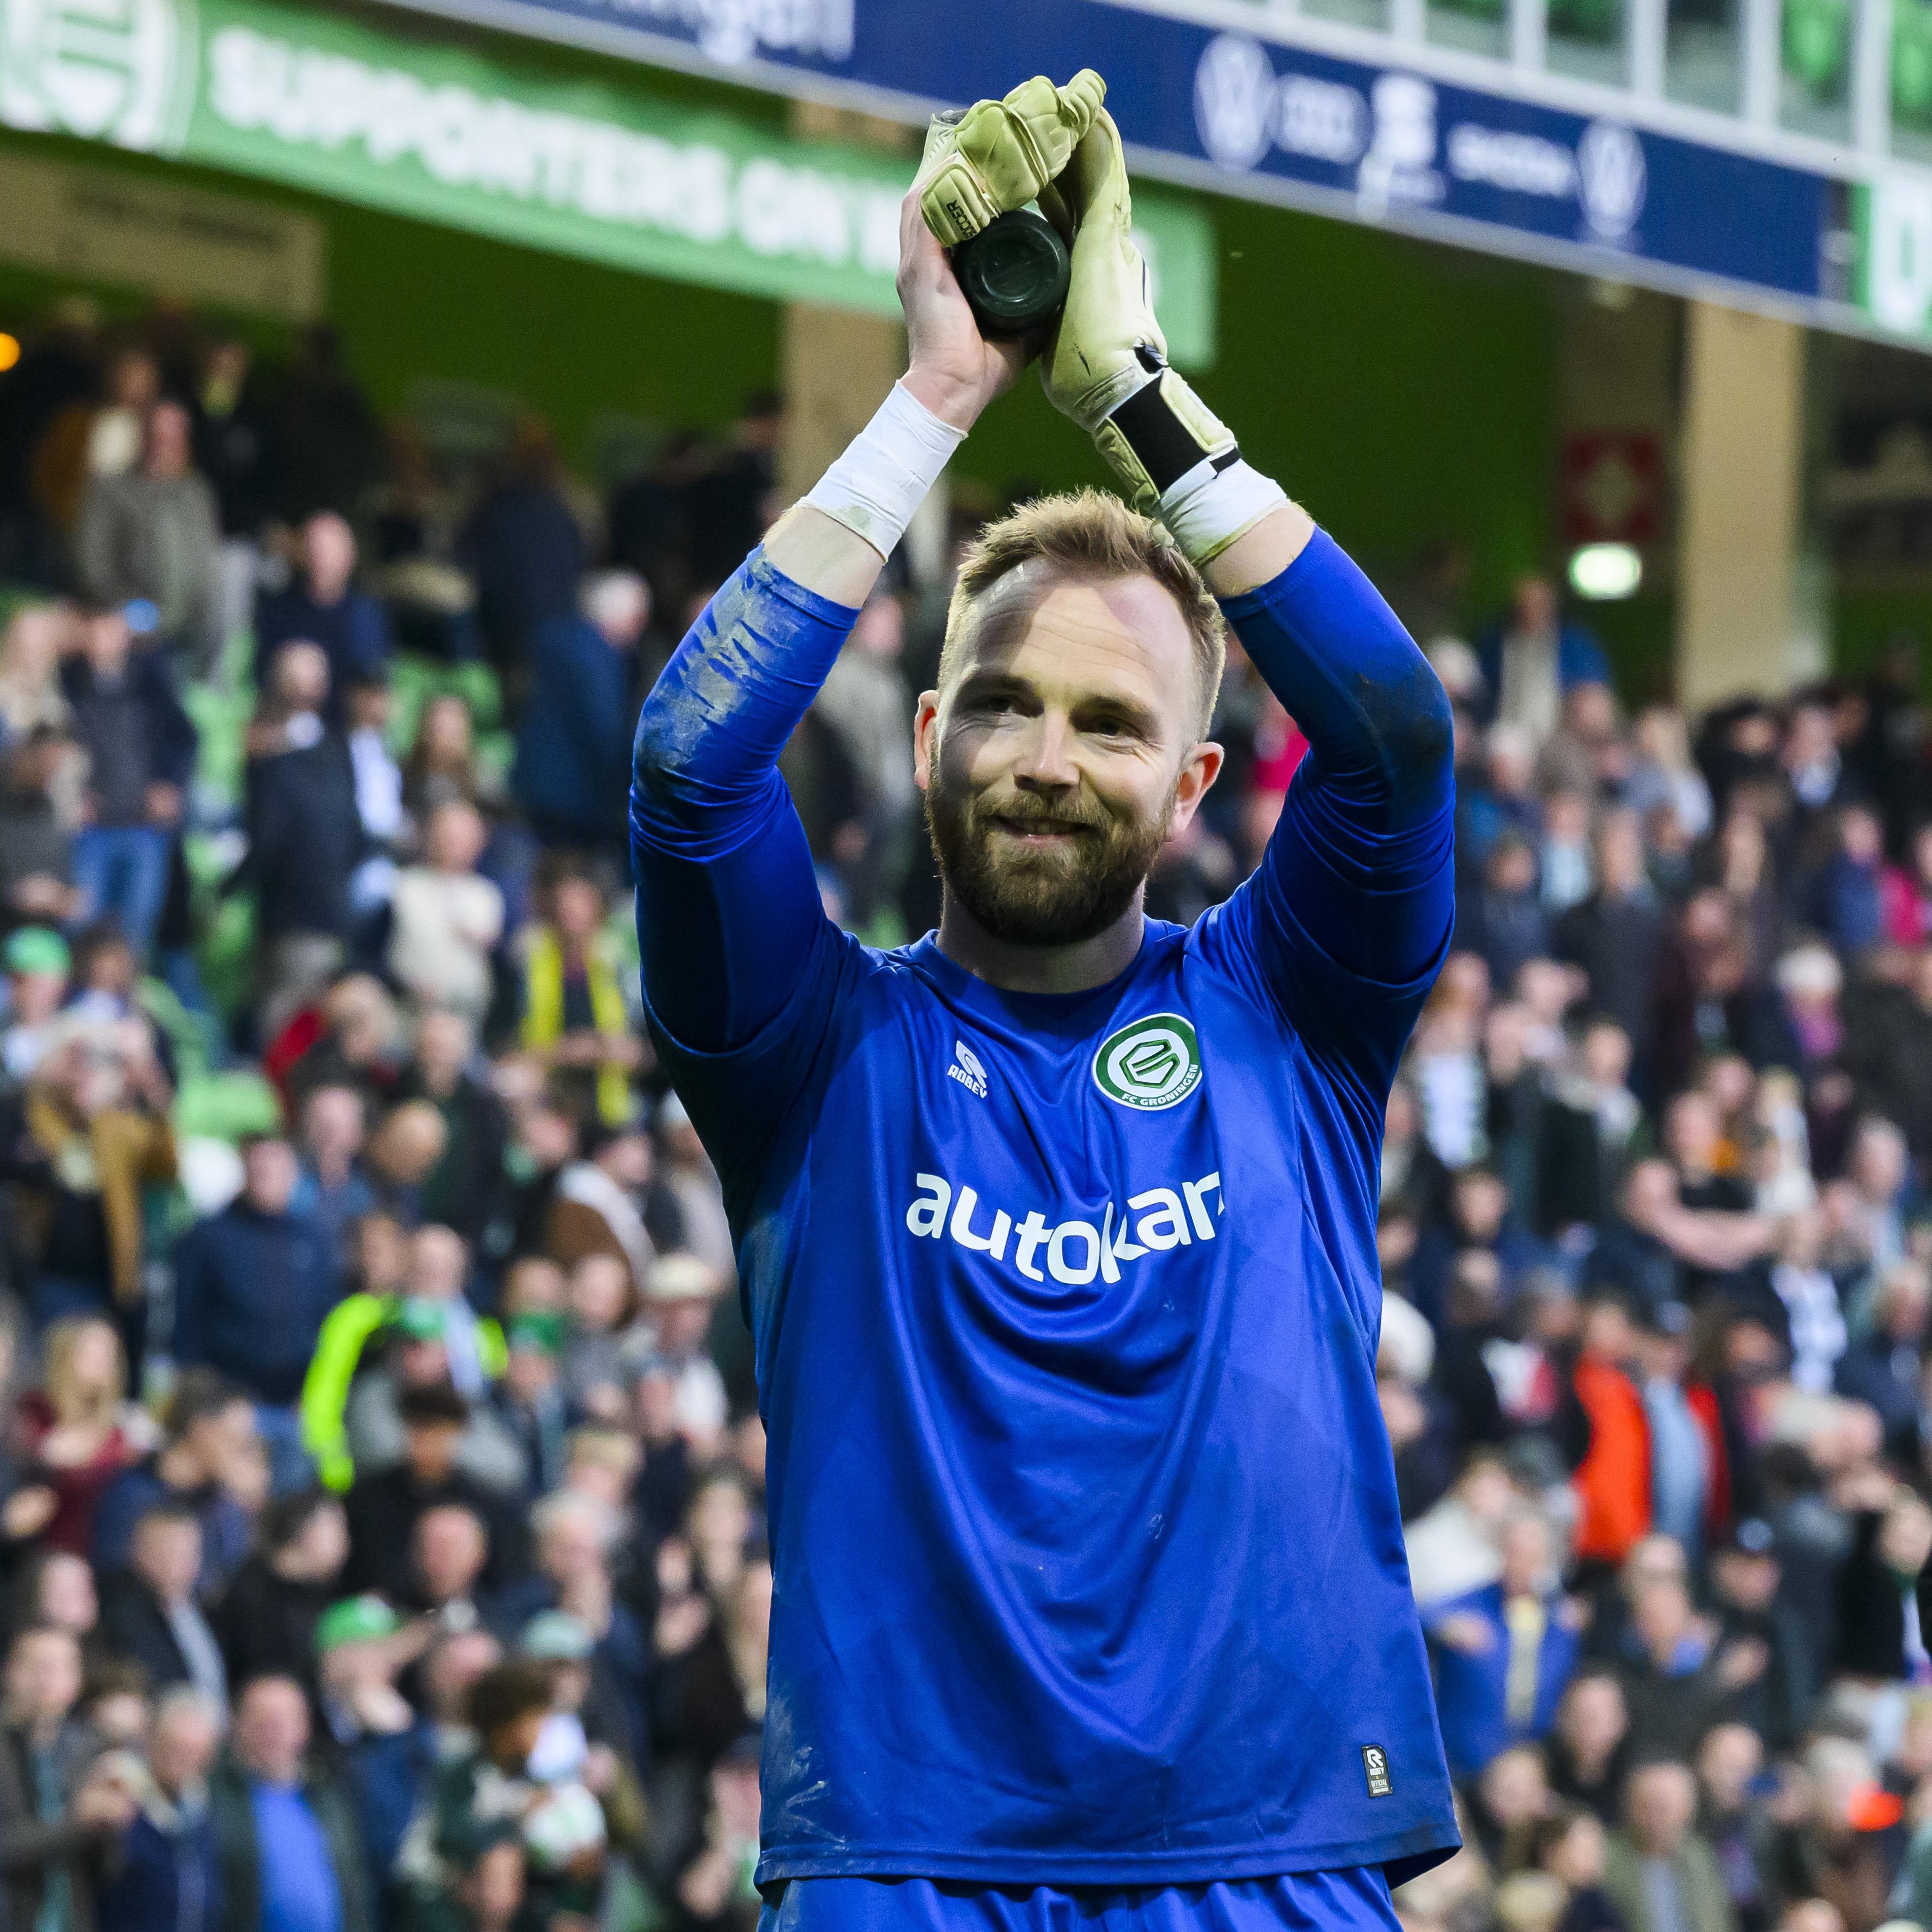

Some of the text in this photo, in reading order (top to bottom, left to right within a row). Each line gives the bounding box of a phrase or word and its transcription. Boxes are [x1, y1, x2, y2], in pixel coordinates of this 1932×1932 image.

[947, 1064, 987, 1099] ROBEY
[1121, 1064, 1199, 1106] FC GRONINGEN
